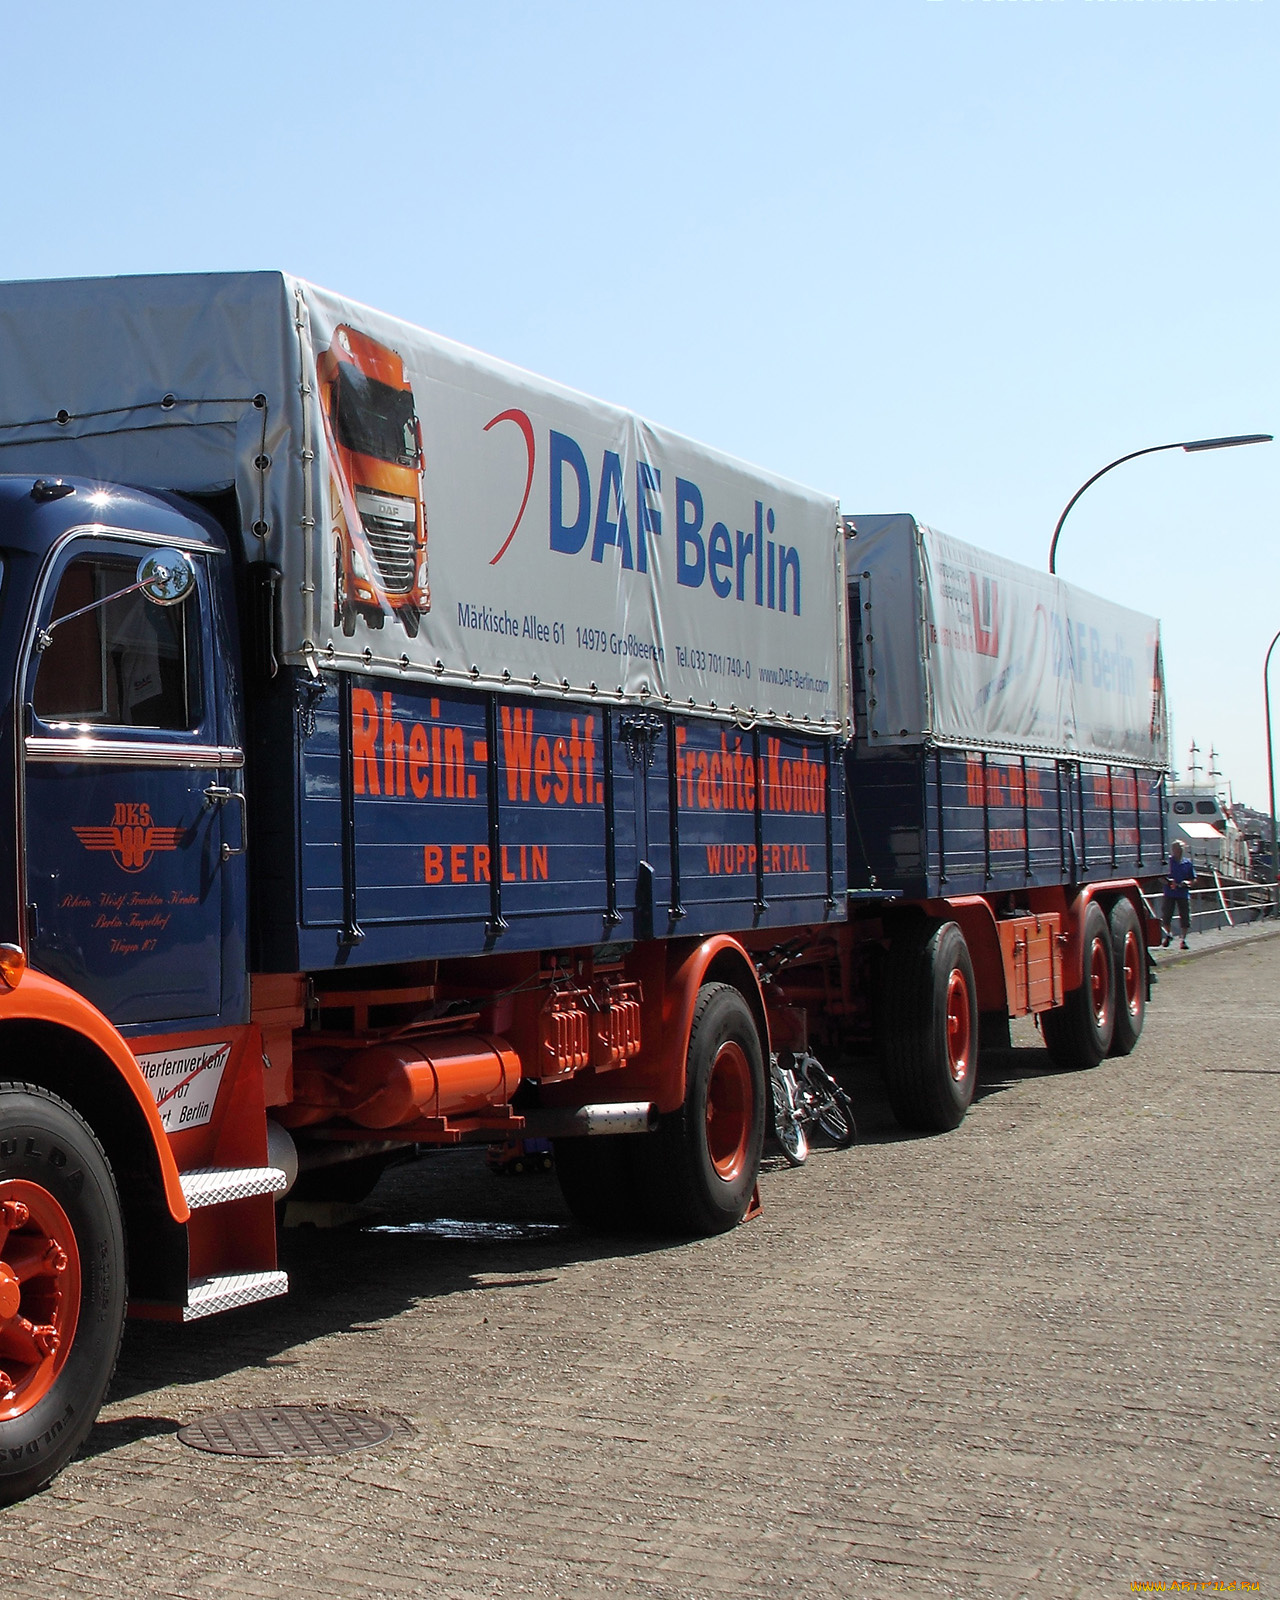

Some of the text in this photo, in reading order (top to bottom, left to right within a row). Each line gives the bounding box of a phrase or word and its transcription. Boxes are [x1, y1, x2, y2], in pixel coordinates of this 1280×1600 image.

[378, 503, 400, 517] DAF
[548, 429, 662, 574] DAF
[675, 476, 801, 617] Berlin
[458, 602, 519, 637] Märkische
[522, 615, 550, 643] Allee
[553, 621, 565, 645] 61
[576, 626, 607, 653] 14979
[758, 667, 829, 694] www.DAF-Berlin.com
[501, 706, 604, 804] Westf.
[676, 726, 827, 814] Frachten Kontor
[114, 803, 150, 826] DKS
[424, 845, 549, 884] BERLIN
[706, 845, 811, 875] WUPPERTAL
[139, 1050, 226, 1080] üterfernverkehr
[179, 1101, 209, 1124] Berlin
